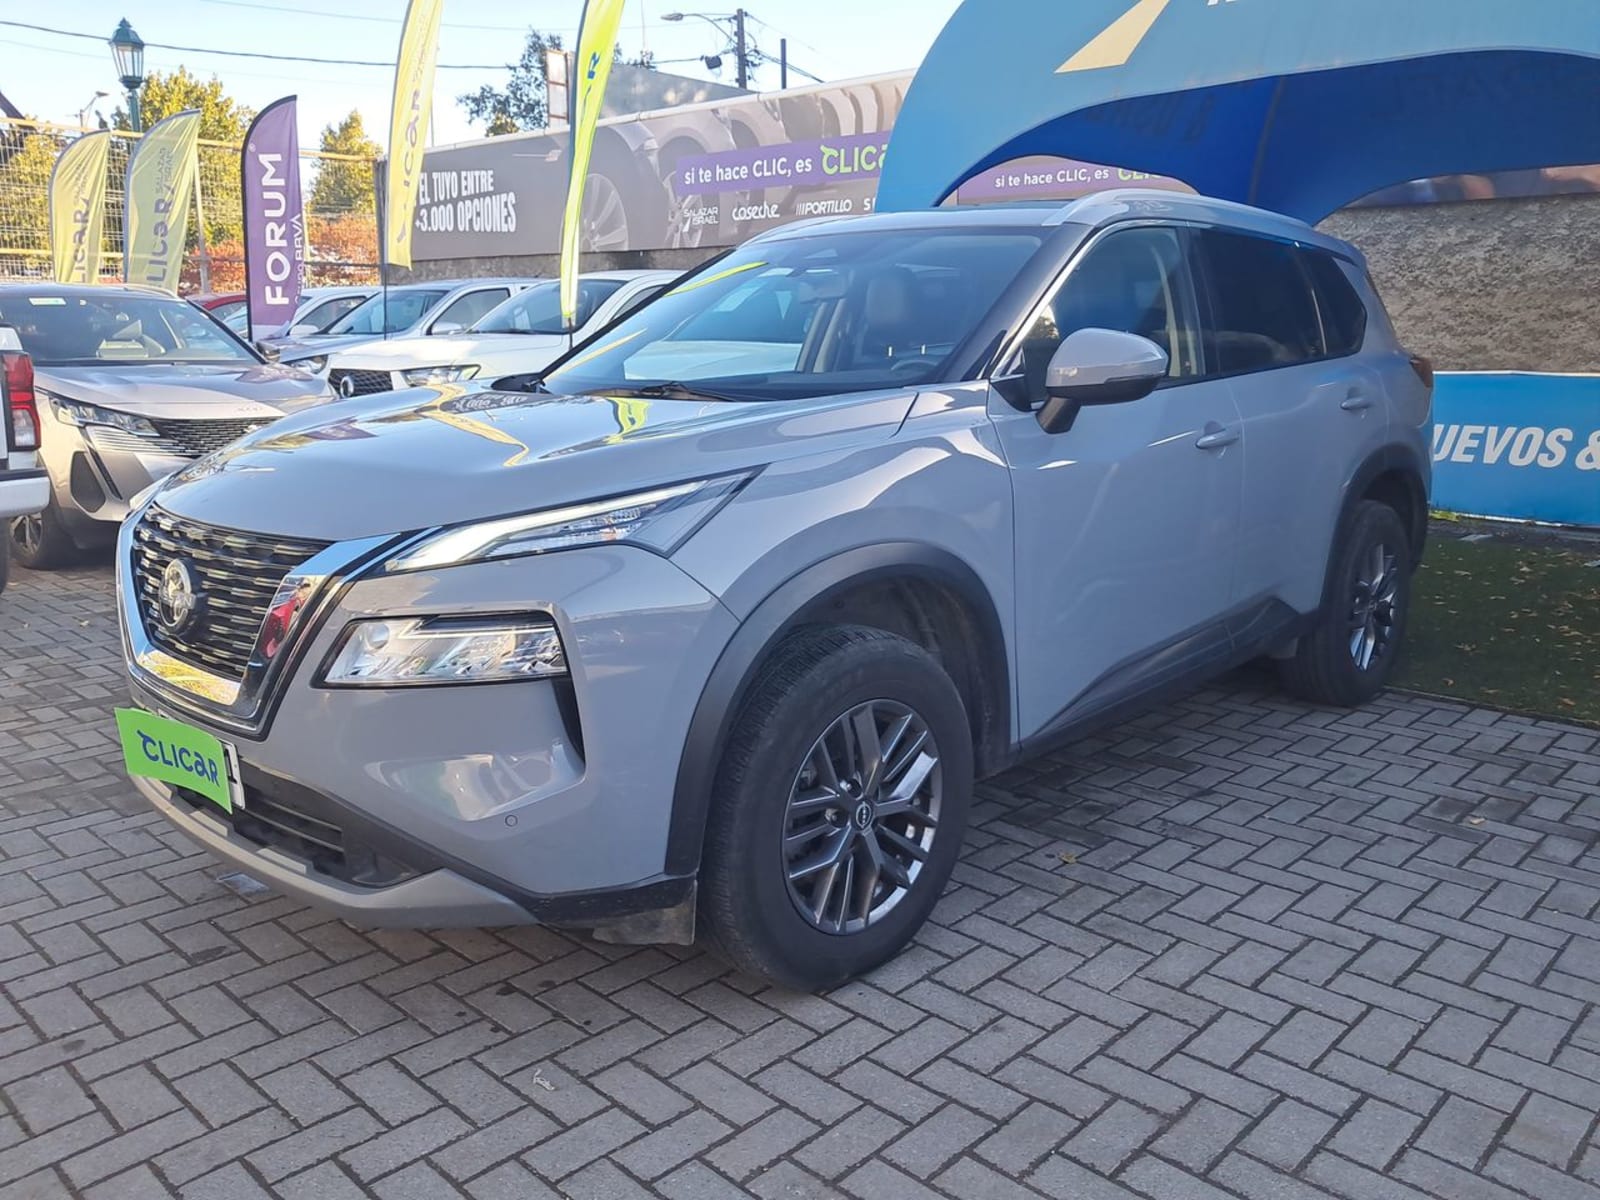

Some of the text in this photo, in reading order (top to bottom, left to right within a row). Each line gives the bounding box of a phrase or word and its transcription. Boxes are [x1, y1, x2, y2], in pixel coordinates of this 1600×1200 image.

[419, 170, 494, 205] EL TUYO ENTRE
[685, 167, 694, 184] si
[699, 167, 712, 183] te
[716, 165, 748, 181] hace
[752, 157, 791, 177] CLIC,
[795, 158, 813, 173] es
[995, 176, 1005, 187] si
[1008, 175, 1020, 186] te
[1024, 173, 1052, 185] hace
[1056, 169, 1091, 183] CLIC,
[1094, 169, 1109, 180] es
[415, 191, 516, 232] +3.000 OPCIONES
[732, 200, 780, 220] coseche
[258, 153, 290, 305] FORUM
[1575, 429, 1600, 470] &
